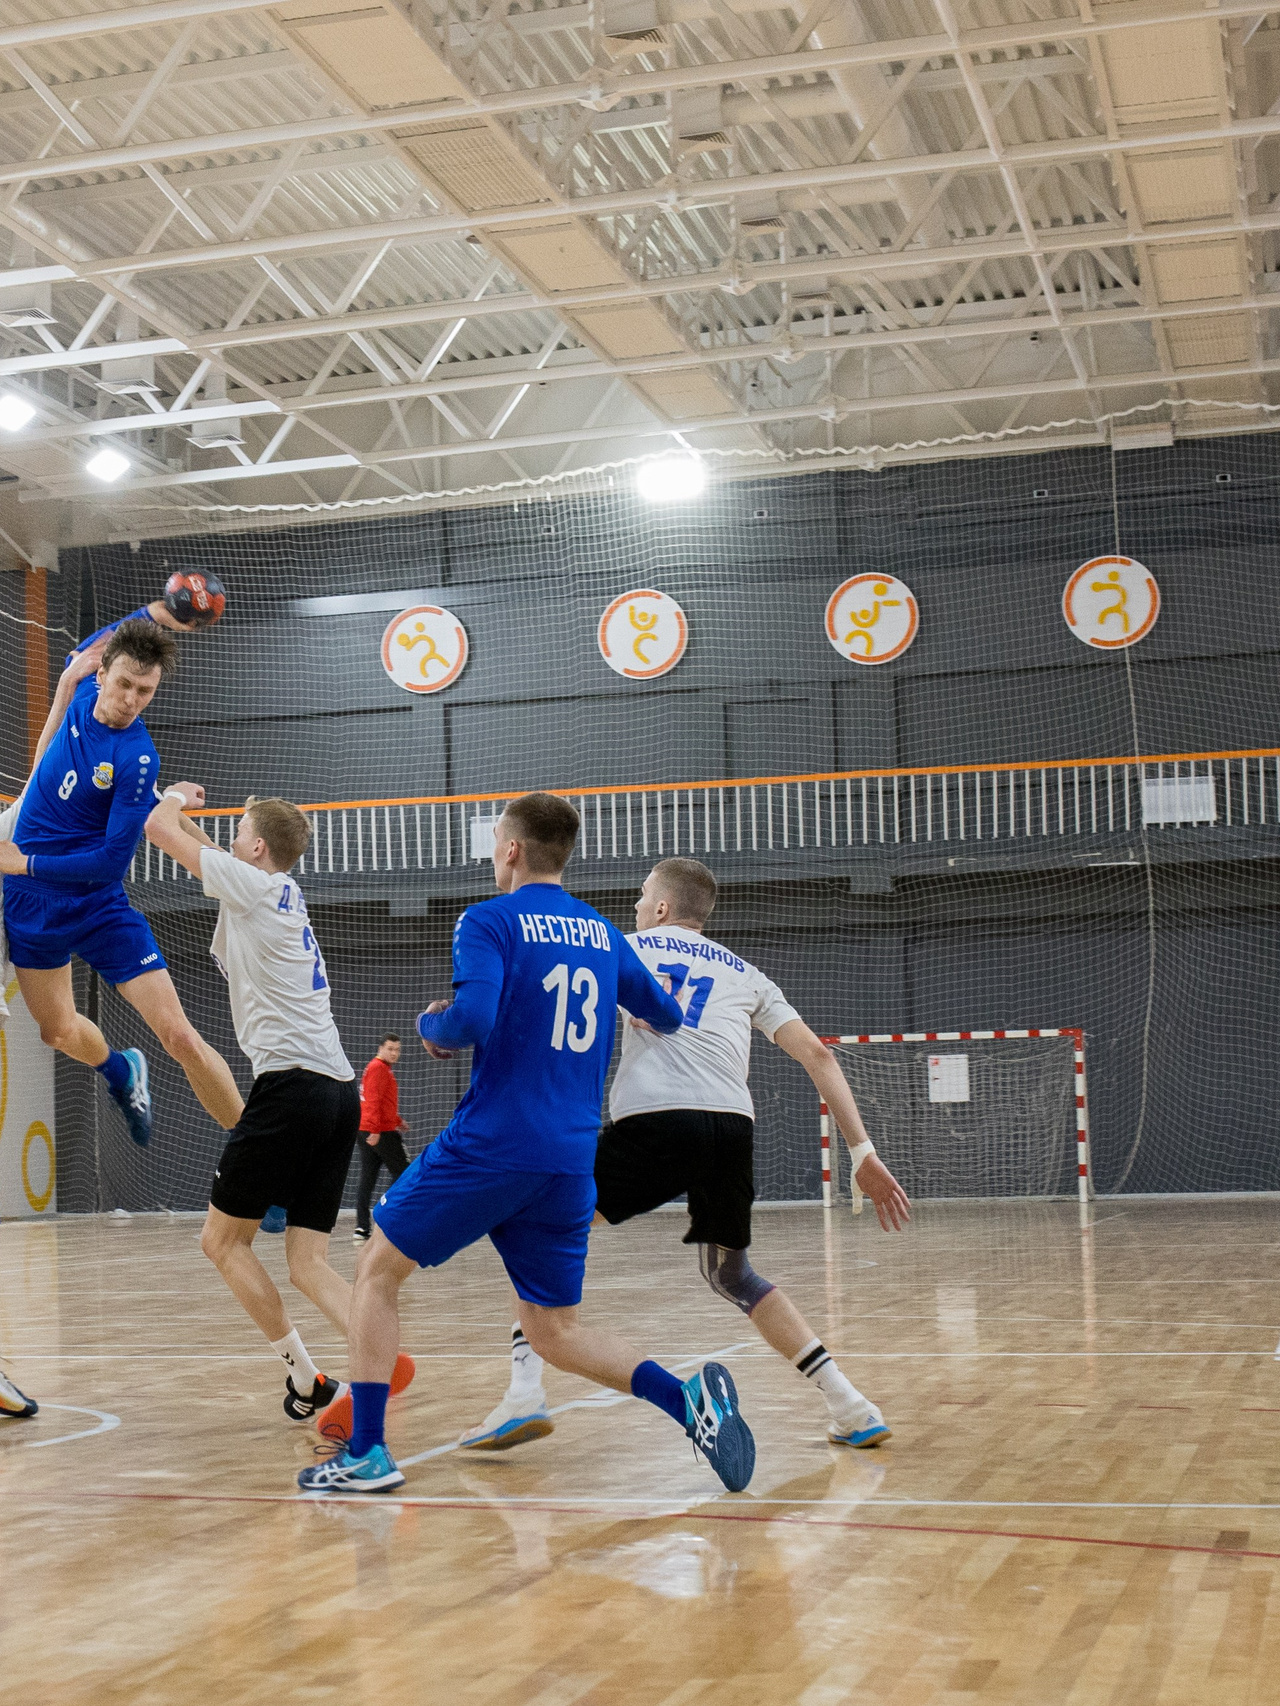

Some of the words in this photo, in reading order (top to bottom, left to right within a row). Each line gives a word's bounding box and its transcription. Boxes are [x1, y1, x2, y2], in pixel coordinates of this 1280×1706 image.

[58, 769, 78, 800] 9
[518, 913, 611, 952] НЕСТЕРОВ
[637, 934, 746, 973] МЕДВЕДНОВ
[541, 963, 599, 1053] 13
